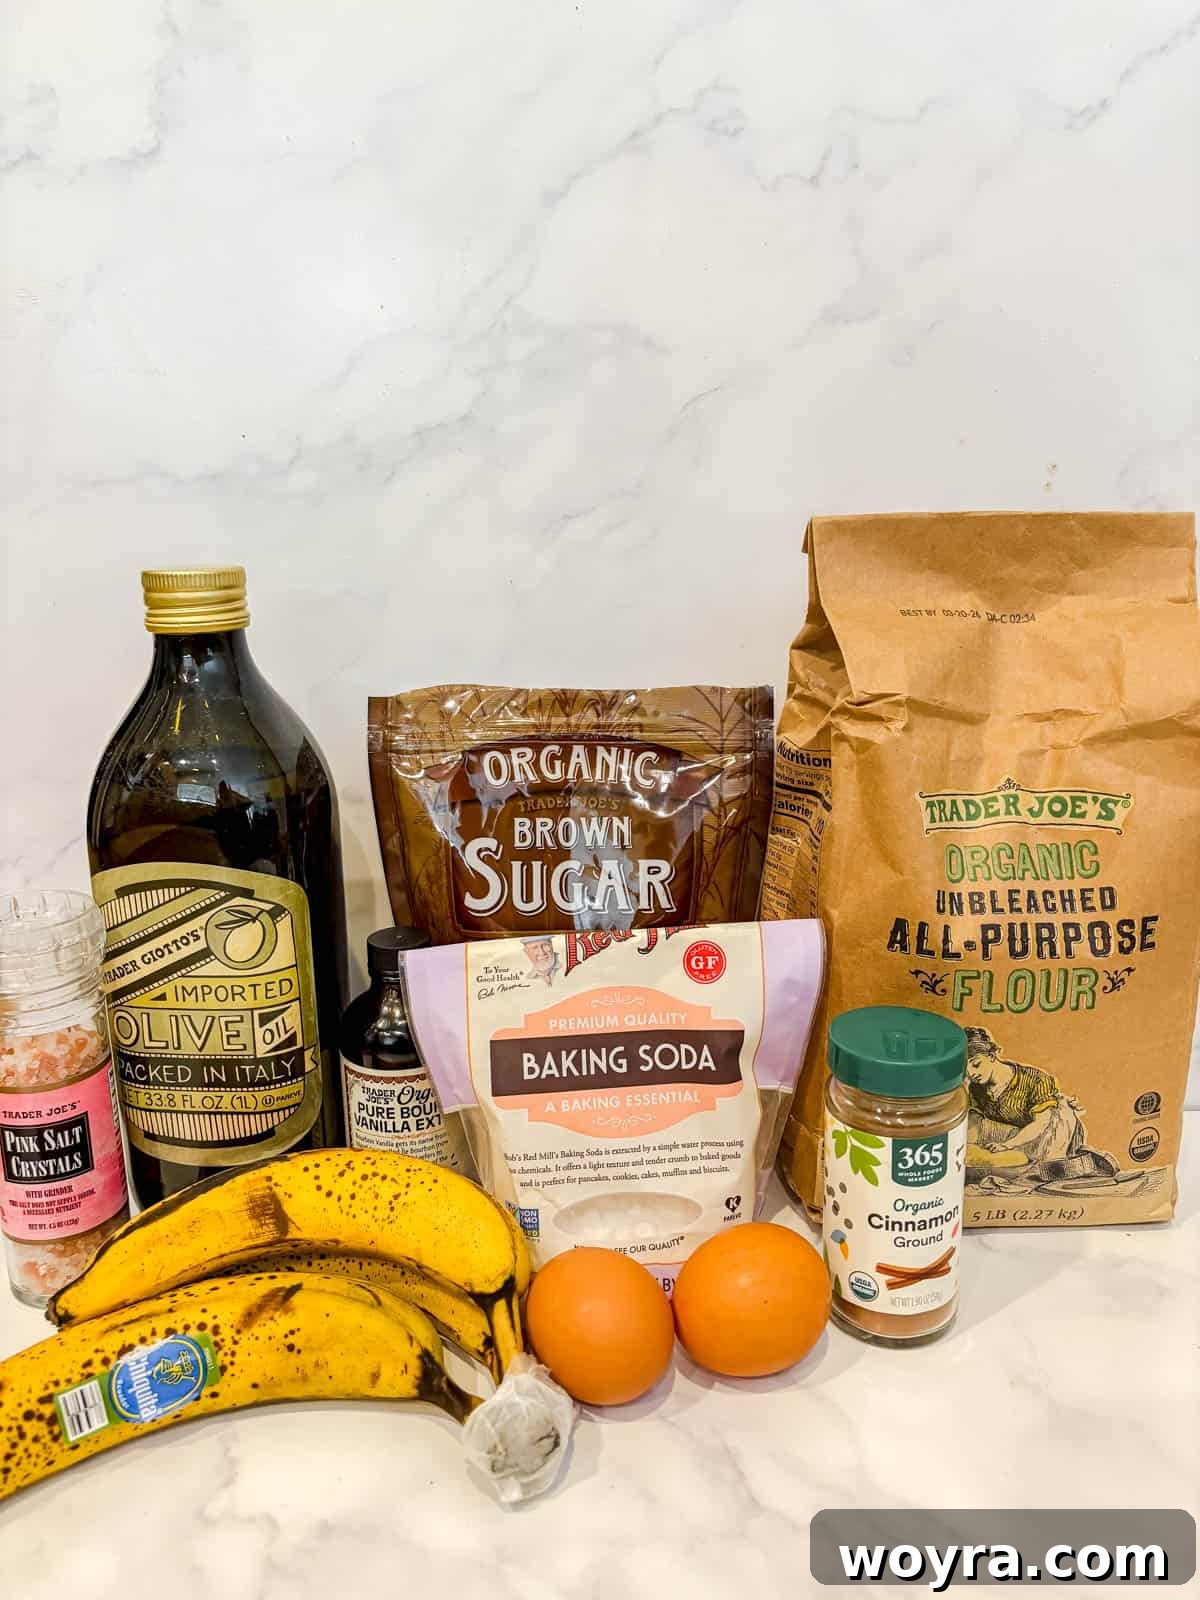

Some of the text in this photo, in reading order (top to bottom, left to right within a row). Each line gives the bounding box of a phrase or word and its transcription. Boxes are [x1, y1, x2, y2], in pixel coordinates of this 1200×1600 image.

[482, 744, 660, 787] ORGANIC
[776, 741, 831, 768] Nutrition
[924, 793, 1122, 824] TRADER JOE'S
[512, 815, 633, 850] BROWN
[945, 839, 1100, 884] ORGANIC
[463, 837, 678, 917] SUGAR
[935, 886, 1117, 916] UNBLEACHED
[140, 929, 201, 965] GIOTTO'S
[886, 915, 1160, 961] ALL-PURPOSE
[483, 965, 509, 974] To Your
[690, 956, 719, 970] GF
[173, 978, 294, 1003] IMPORTED
[951, 967, 1099, 1014] FLOUR
[114, 1010, 248, 1052] OLIVE
[261, 1016, 296, 1046] OIL
[549, 1012, 688, 1031] PREMIUM QUALITY
[119, 1057, 296, 1084] PACKED IN ITALY
[522, 1042, 716, 1080] BAKING SODA
[125, 1088, 140, 1105] ET
[145, 1091, 177, 1108] 33.8
[231, 1094, 259, 1111] (1L)
[361, 1085, 396, 1098] TRADER
[397, 1085, 434, 1106] Org
[544, 1091, 700, 1113] A BAKING ESSENTIAL
[2, 1110, 43, 1120] TRADER
[354, 1112, 411, 1133] VANILLA
[358, 1102, 396, 1120] PURE
[4, 1125, 83, 1153] PINK SALT
[376, 1138, 394, 1147] Vanilla
[504, 1152, 521, 1161] ob's
[523, 1152, 537, 1161] Red
[539, 1151, 559, 1160] Mill's
[560, 1149, 584, 1159] Baking
[586, 1147, 603, 1156] Soda
[604, 1147, 610, 1155] is
[611, 1144, 641, 1155] extracted
[643, 1144, 651, 1153] by
[658, 1141, 680, 1152] simple
[681, 1141, 699, 1149] water
[701, 1140, 725, 1150] process
[726, 1139, 744, 1148] using
[11, 1152, 83, 1178] CRYSTALS
[555, 1164, 561, 1172] It
[562, 1162, 581, 1171] offers
[589, 1161, 604, 1171] light
[632, 1158, 644, 1167] and
[645, 1155, 666, 1165] tender
[667, 1153, 690, 1163] crumb
[700, 1152, 720, 1161] baked
[721, 1151, 741, 1162] goods
[897, 1142, 944, 1169] 365
[520, 1179, 533, 1187] and
[534, 1179, 540, 1187] is
[542, 1177, 565, 1188] perfect
[566, 1176, 576, 1184] for
[662, 1167, 688, 1177] muffins
[689, 1166, 702, 1175] and
[25, 1185, 73, 1199] WITH GRINDER
[893, 1196, 945, 1216] Organic
[970, 1207, 1085, 1222] 5 LB (2.27 kg)
[867, 1205, 960, 1232] Cinnamon
[629, 1245, 647, 1254] OUR
[649, 1237, 681, 1251] QUALITY
[893, 1230, 944, 1249] Ground
